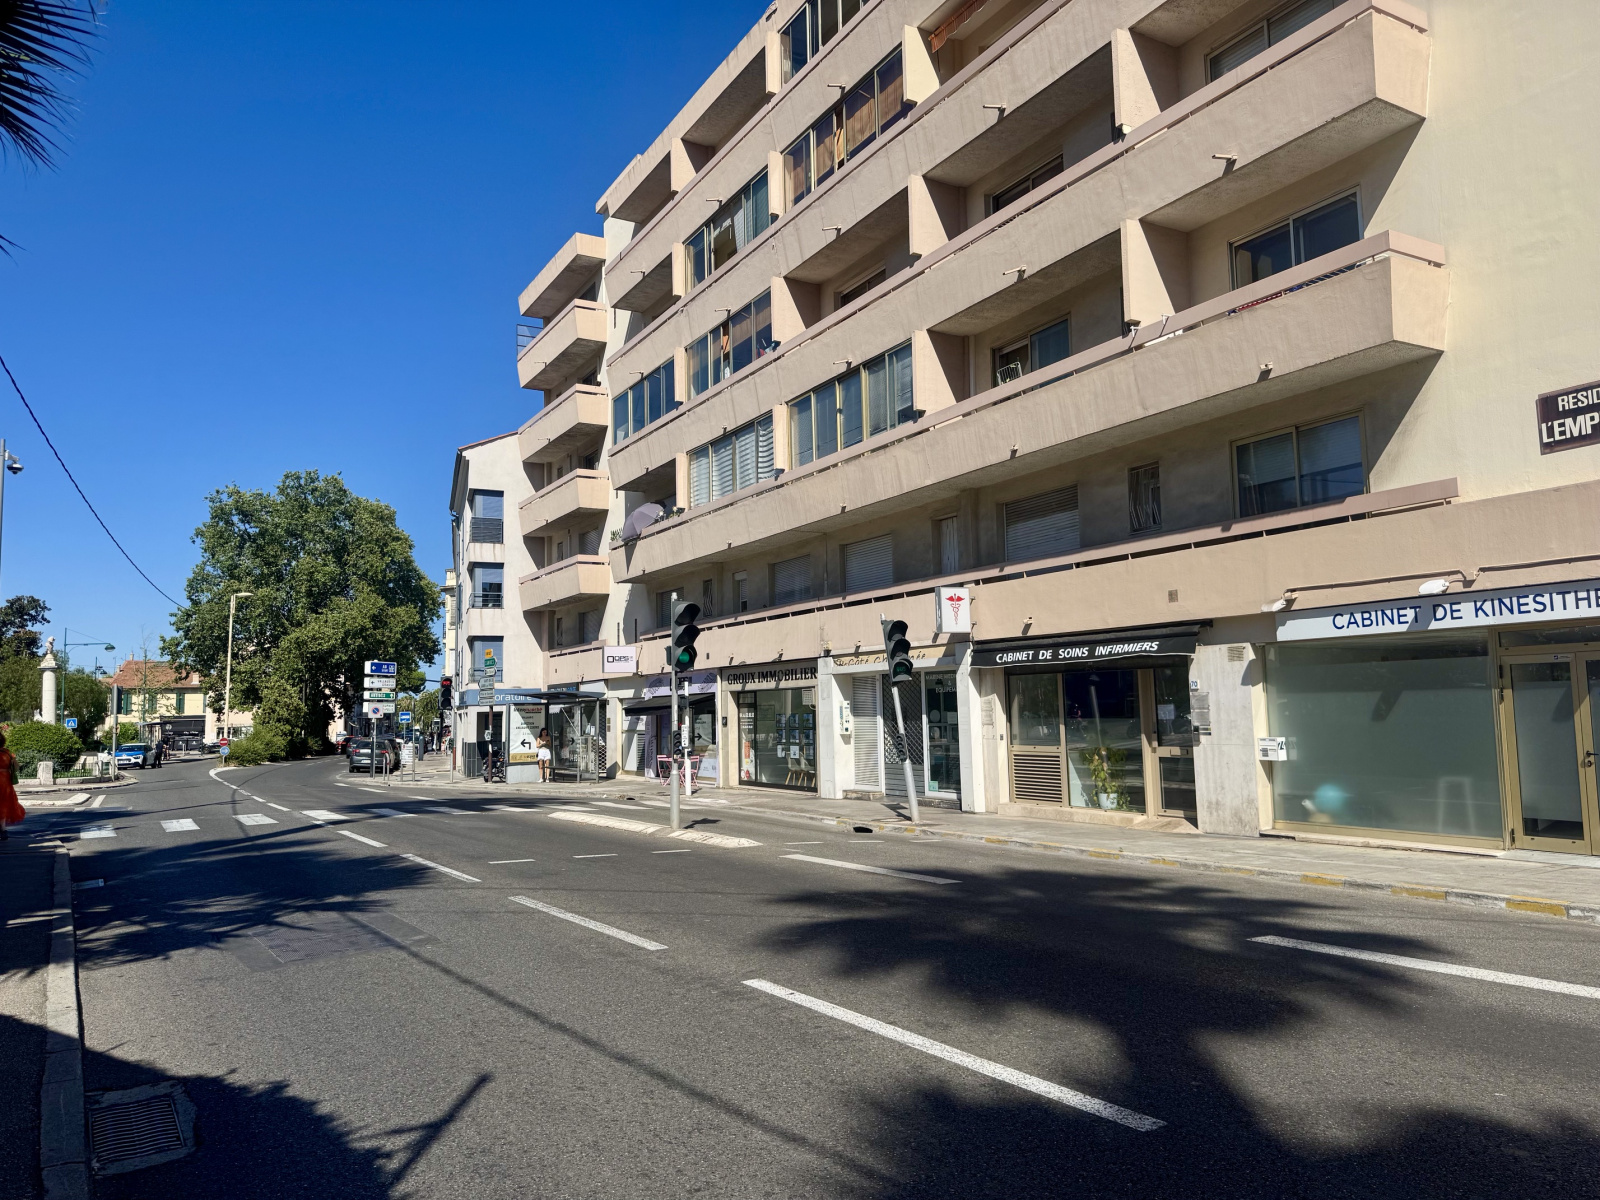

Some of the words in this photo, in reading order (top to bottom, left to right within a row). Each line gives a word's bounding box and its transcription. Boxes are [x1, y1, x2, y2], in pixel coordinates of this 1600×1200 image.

[1541, 411, 1600, 443] L'EMP
[1332, 605, 1422, 630] CABINET
[1432, 601, 1463, 622] DE
[996, 650, 1034, 663] CABINET
[1038, 649, 1053, 660] DE
[1058, 647, 1089, 659] SOINS
[1095, 641, 1159, 656] INFIRMIERS
[727, 672, 756, 685] GROUX
[757, 666, 818, 684] IMMOBILIER
[1191, 680, 1198, 688] 70
